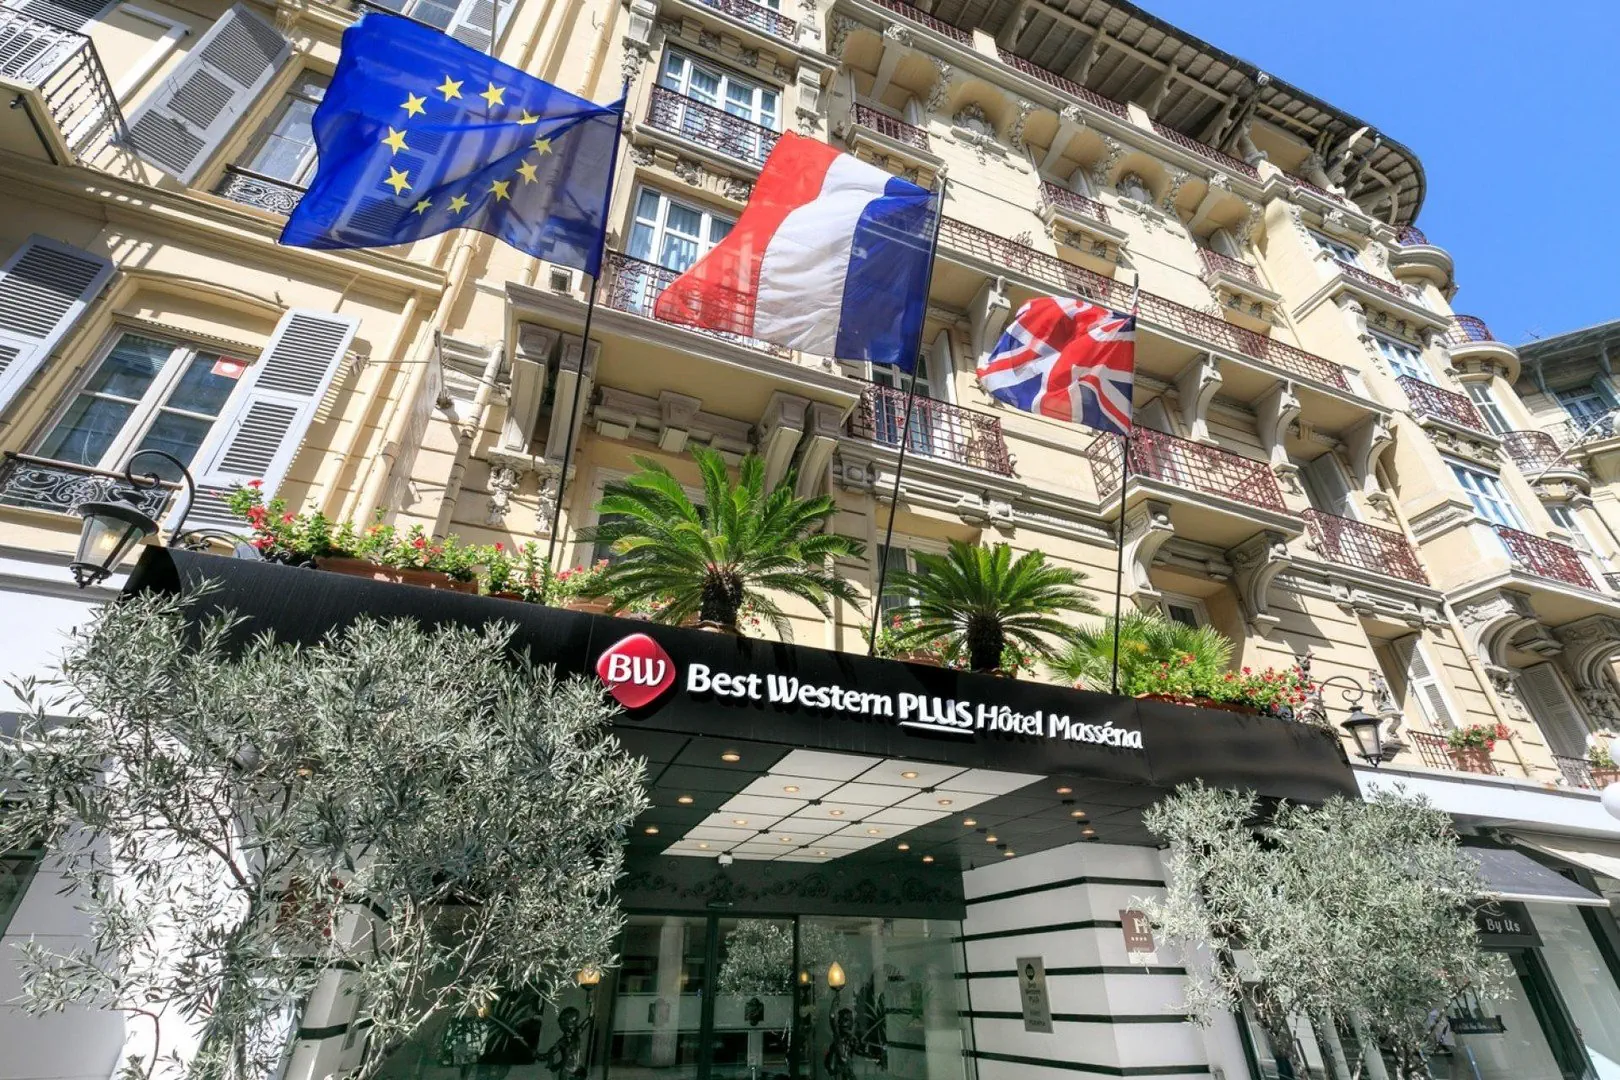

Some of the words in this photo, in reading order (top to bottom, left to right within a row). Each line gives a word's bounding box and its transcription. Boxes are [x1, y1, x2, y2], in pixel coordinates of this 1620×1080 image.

[607, 653, 667, 687] BW
[686, 663, 763, 700] Best
[766, 673, 894, 717] Western
[898, 692, 975, 729] PLUS
[976, 703, 1044, 737] Hôtel
[1049, 713, 1144, 750] Masséna
[1485, 918, 1502, 934] By
[1504, 919, 1521, 932] Us
